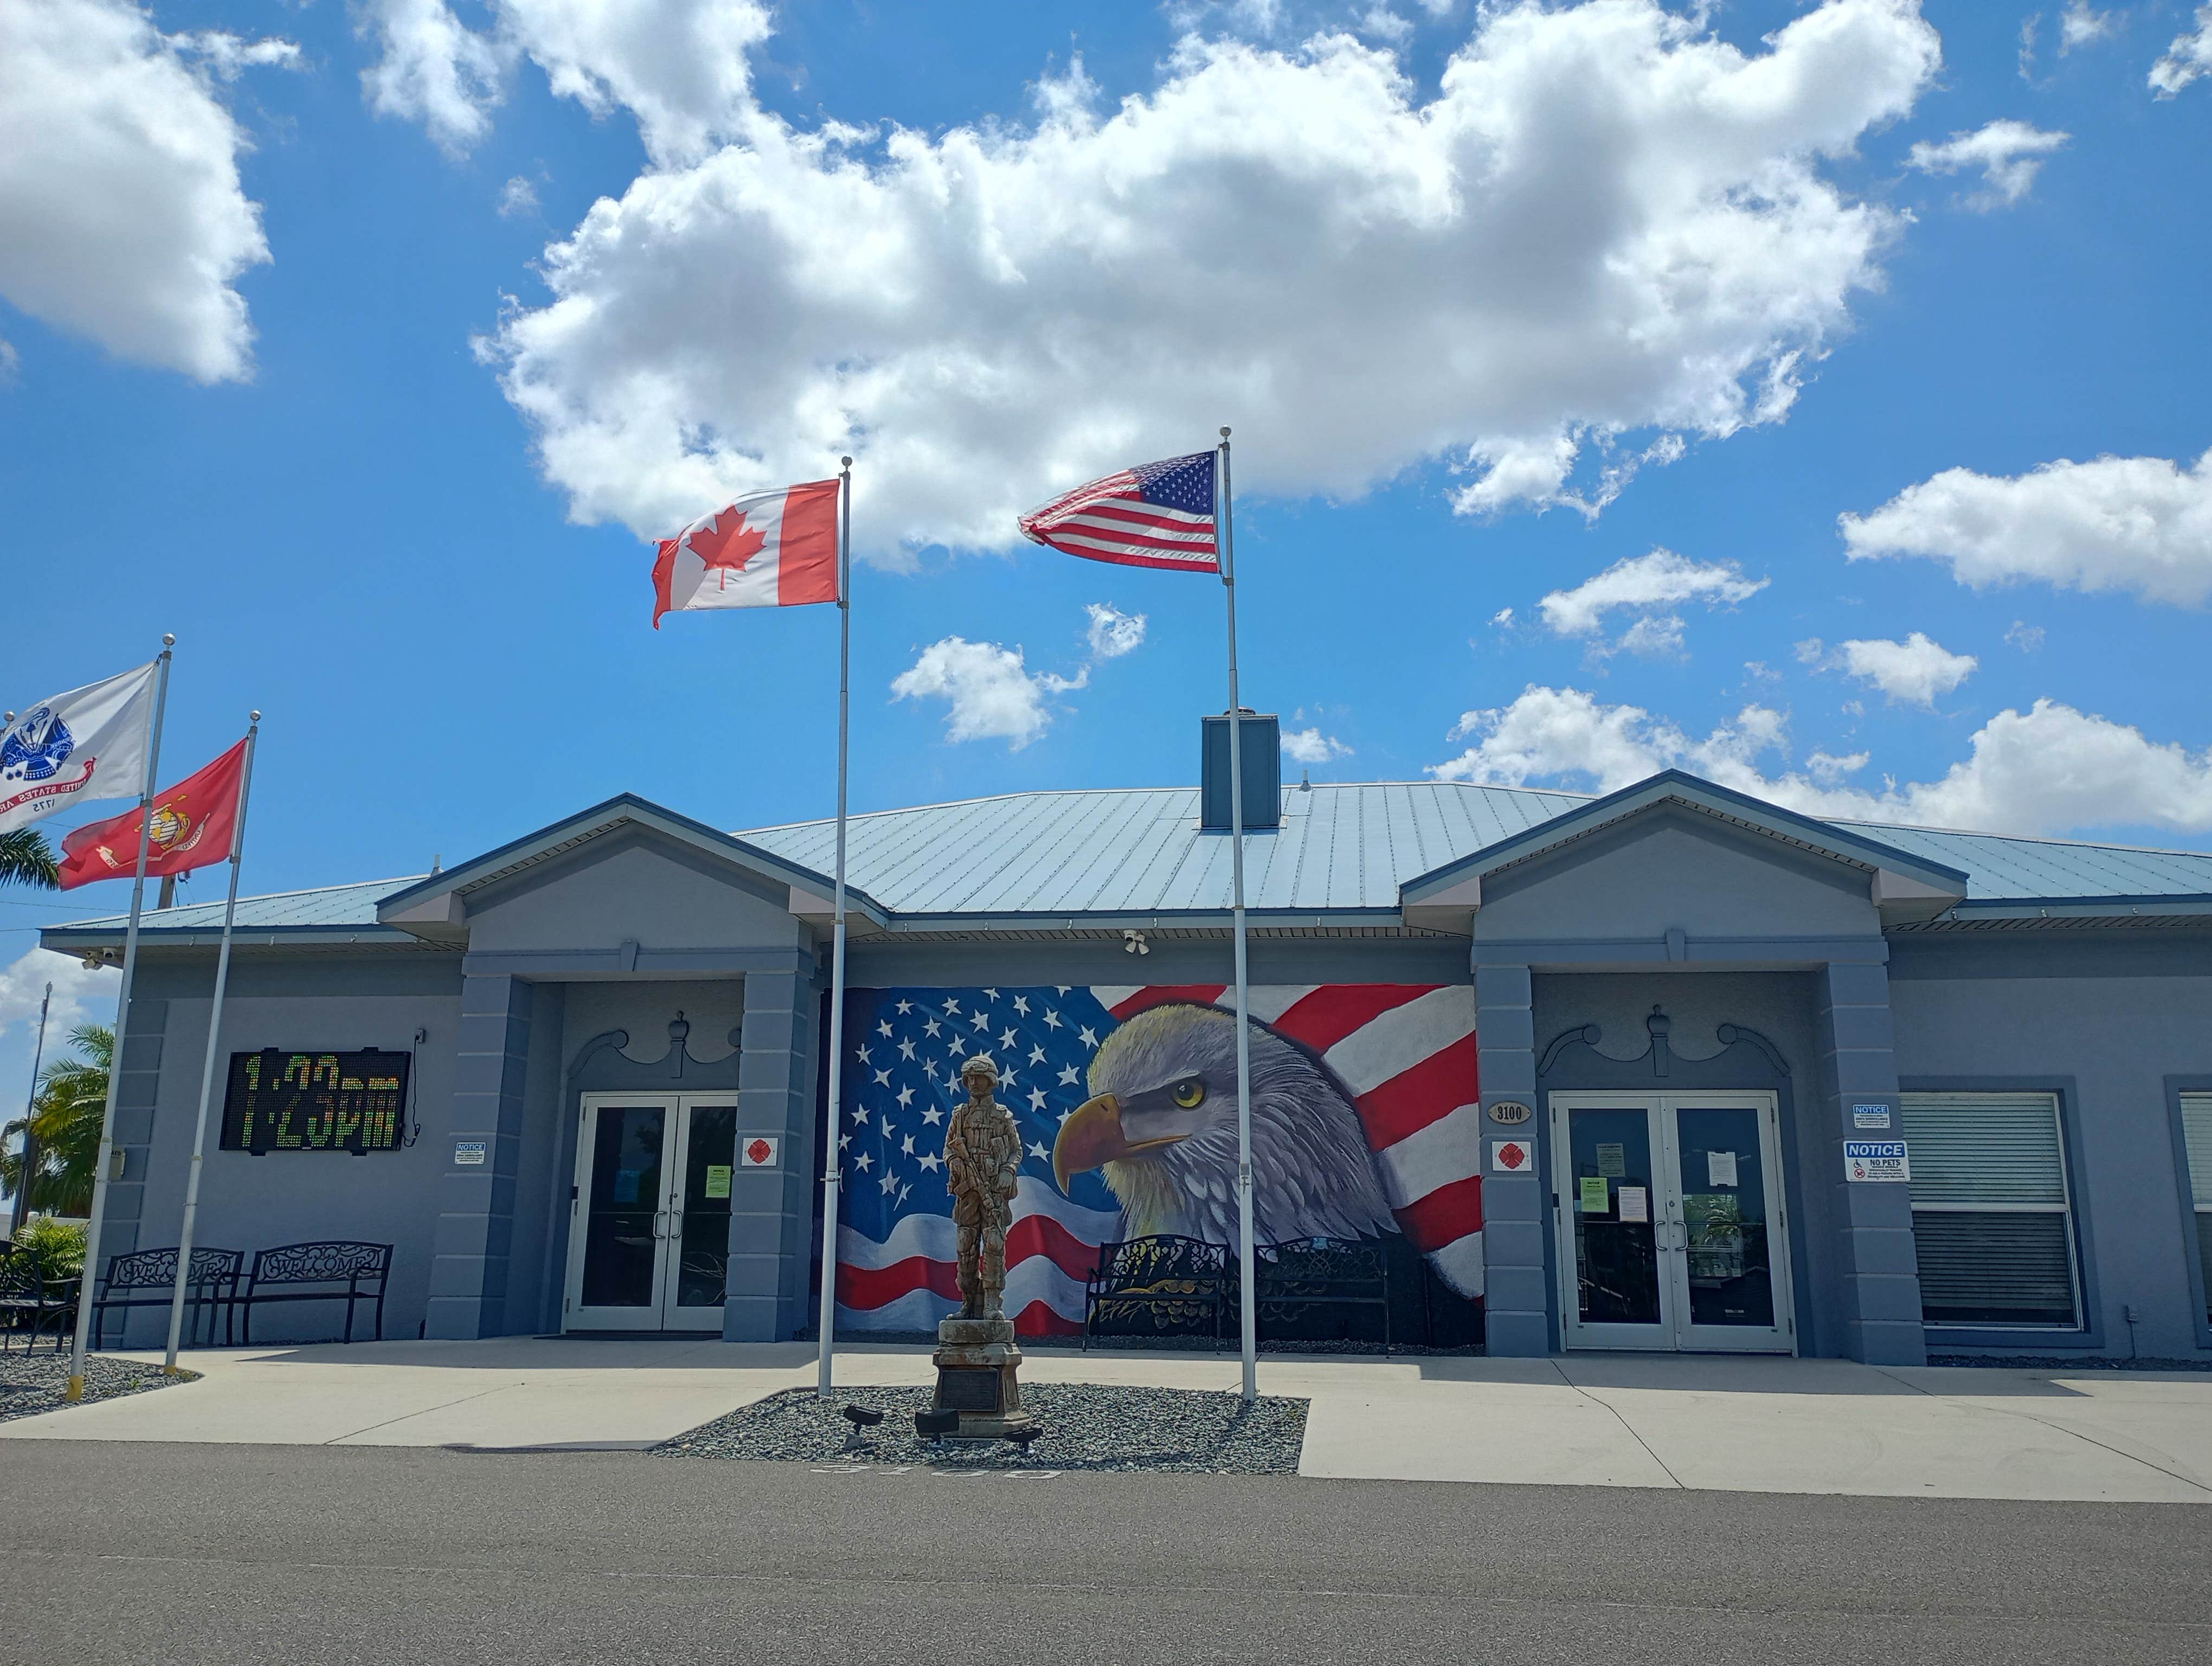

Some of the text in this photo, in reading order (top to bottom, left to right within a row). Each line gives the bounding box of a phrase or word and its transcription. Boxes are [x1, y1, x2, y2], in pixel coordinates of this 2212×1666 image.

[1497, 1106, 1522, 1120] 3100
[1849, 1144, 1903, 1156] NOTICE
[132, 1262, 217, 1277] WELCME
[277, 1256, 366, 1272] WELCOME
